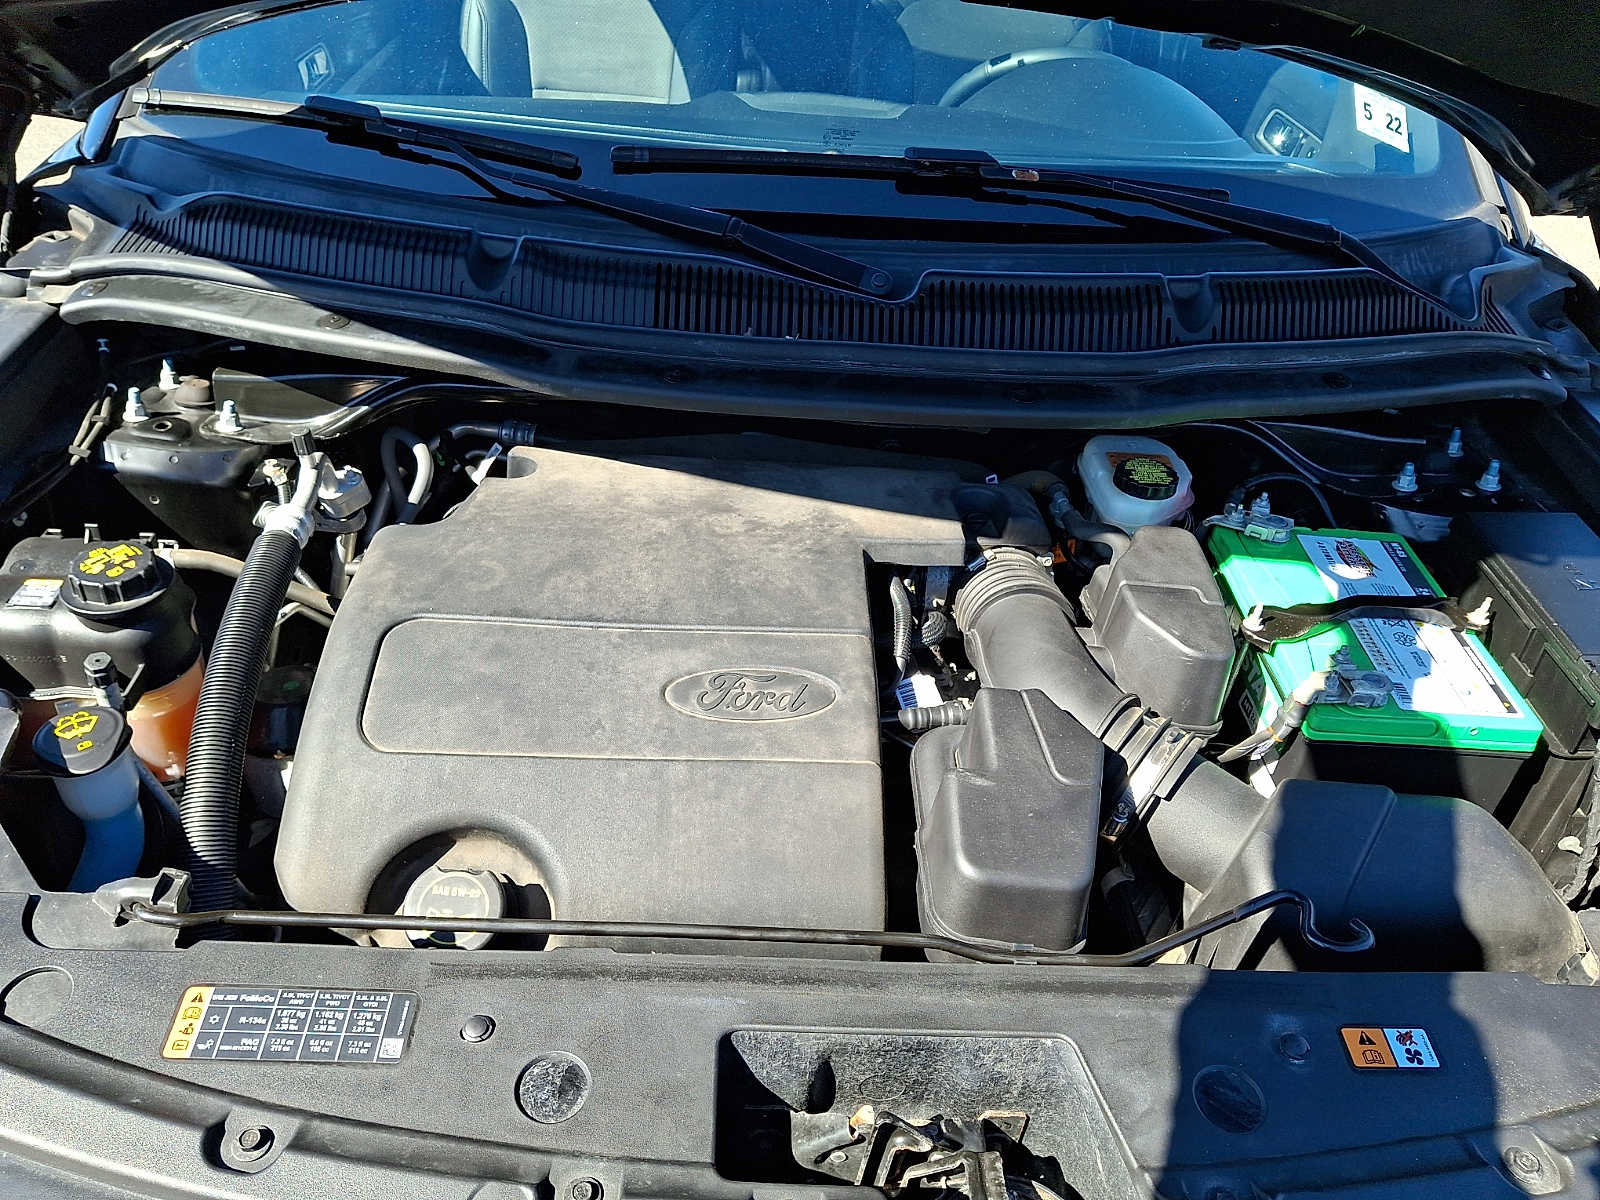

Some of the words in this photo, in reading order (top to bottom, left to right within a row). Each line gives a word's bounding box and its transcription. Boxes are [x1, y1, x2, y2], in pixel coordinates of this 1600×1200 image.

[1364, 102, 1372, 120] 5
[1386, 113, 1402, 135] 22
[697, 673, 808, 712] Ford
